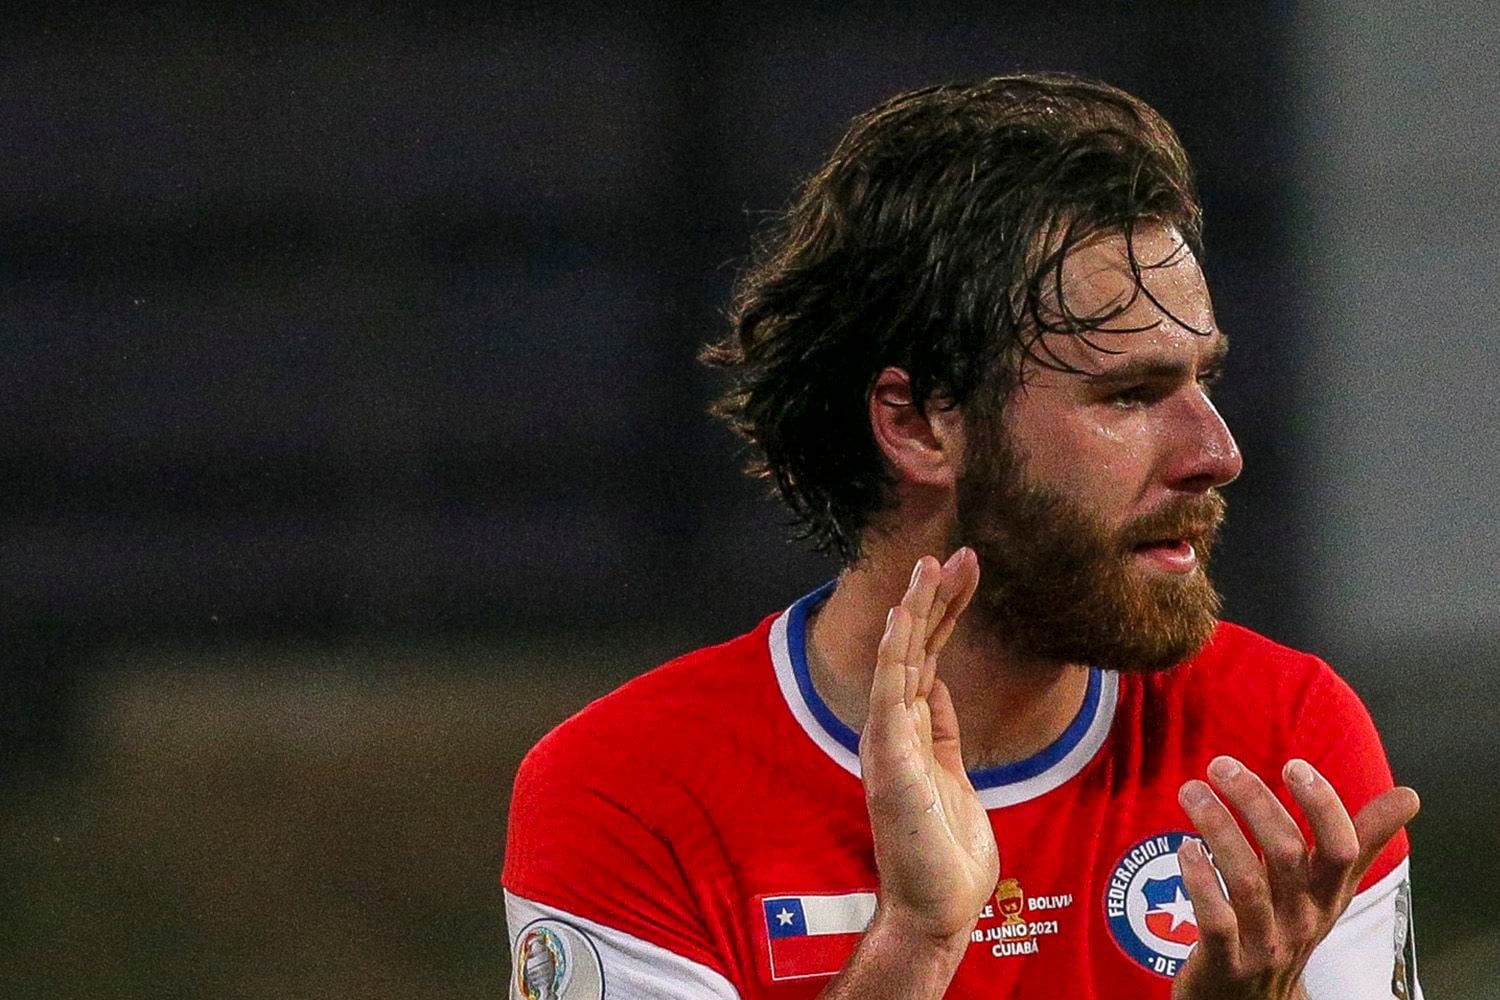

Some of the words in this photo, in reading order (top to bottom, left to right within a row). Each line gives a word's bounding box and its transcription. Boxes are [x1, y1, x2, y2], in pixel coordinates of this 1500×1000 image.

[1108, 836, 1170, 917] FEDERACION
[971, 930, 984, 942] 18
[985, 924, 1027, 941] JUNIO
[1029, 921, 1058, 935] 2021
[992, 938, 1038, 957] CUIABÁ
[1154, 957, 1177, 976] DE
